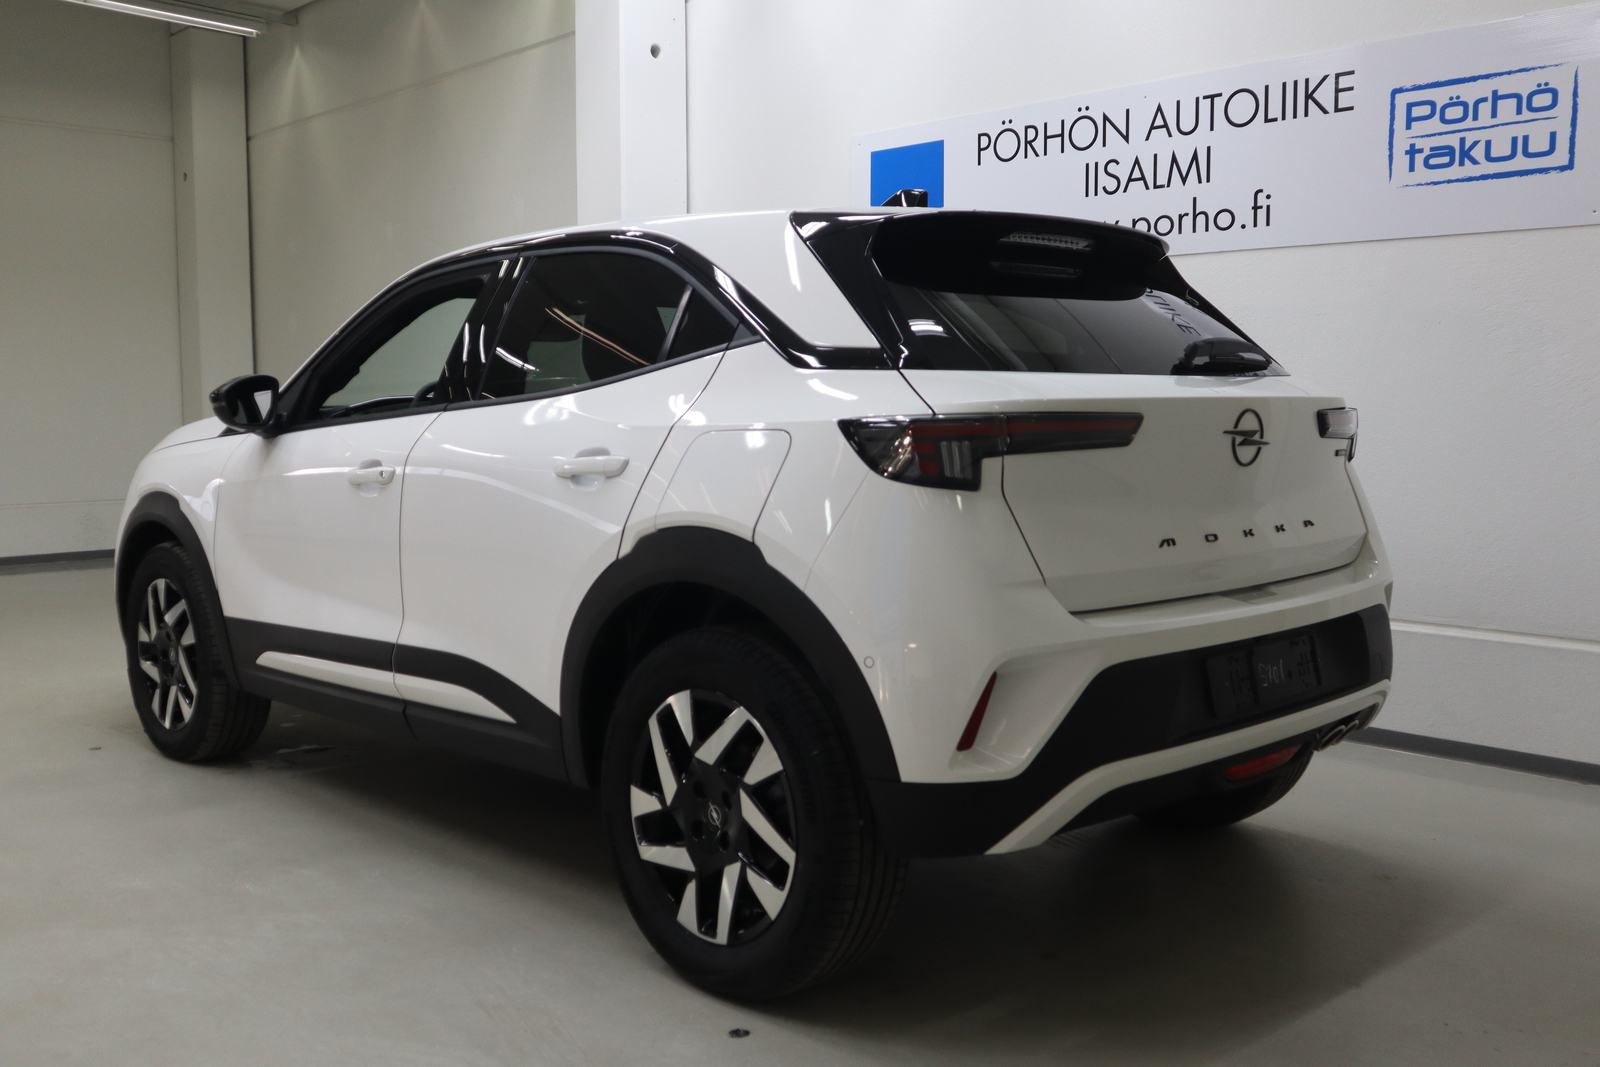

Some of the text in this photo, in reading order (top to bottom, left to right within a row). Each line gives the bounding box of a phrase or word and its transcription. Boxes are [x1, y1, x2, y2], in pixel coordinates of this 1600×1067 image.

[977, 69, 1356, 166] PÖRHÖN AUTOLIIKE
[1404, 81, 1561, 131] Pörhö
[1085, 145, 1212, 199] IISALMI
[1403, 130, 1559, 173] takuu
[1158, 519, 1316, 549] MOKKA
